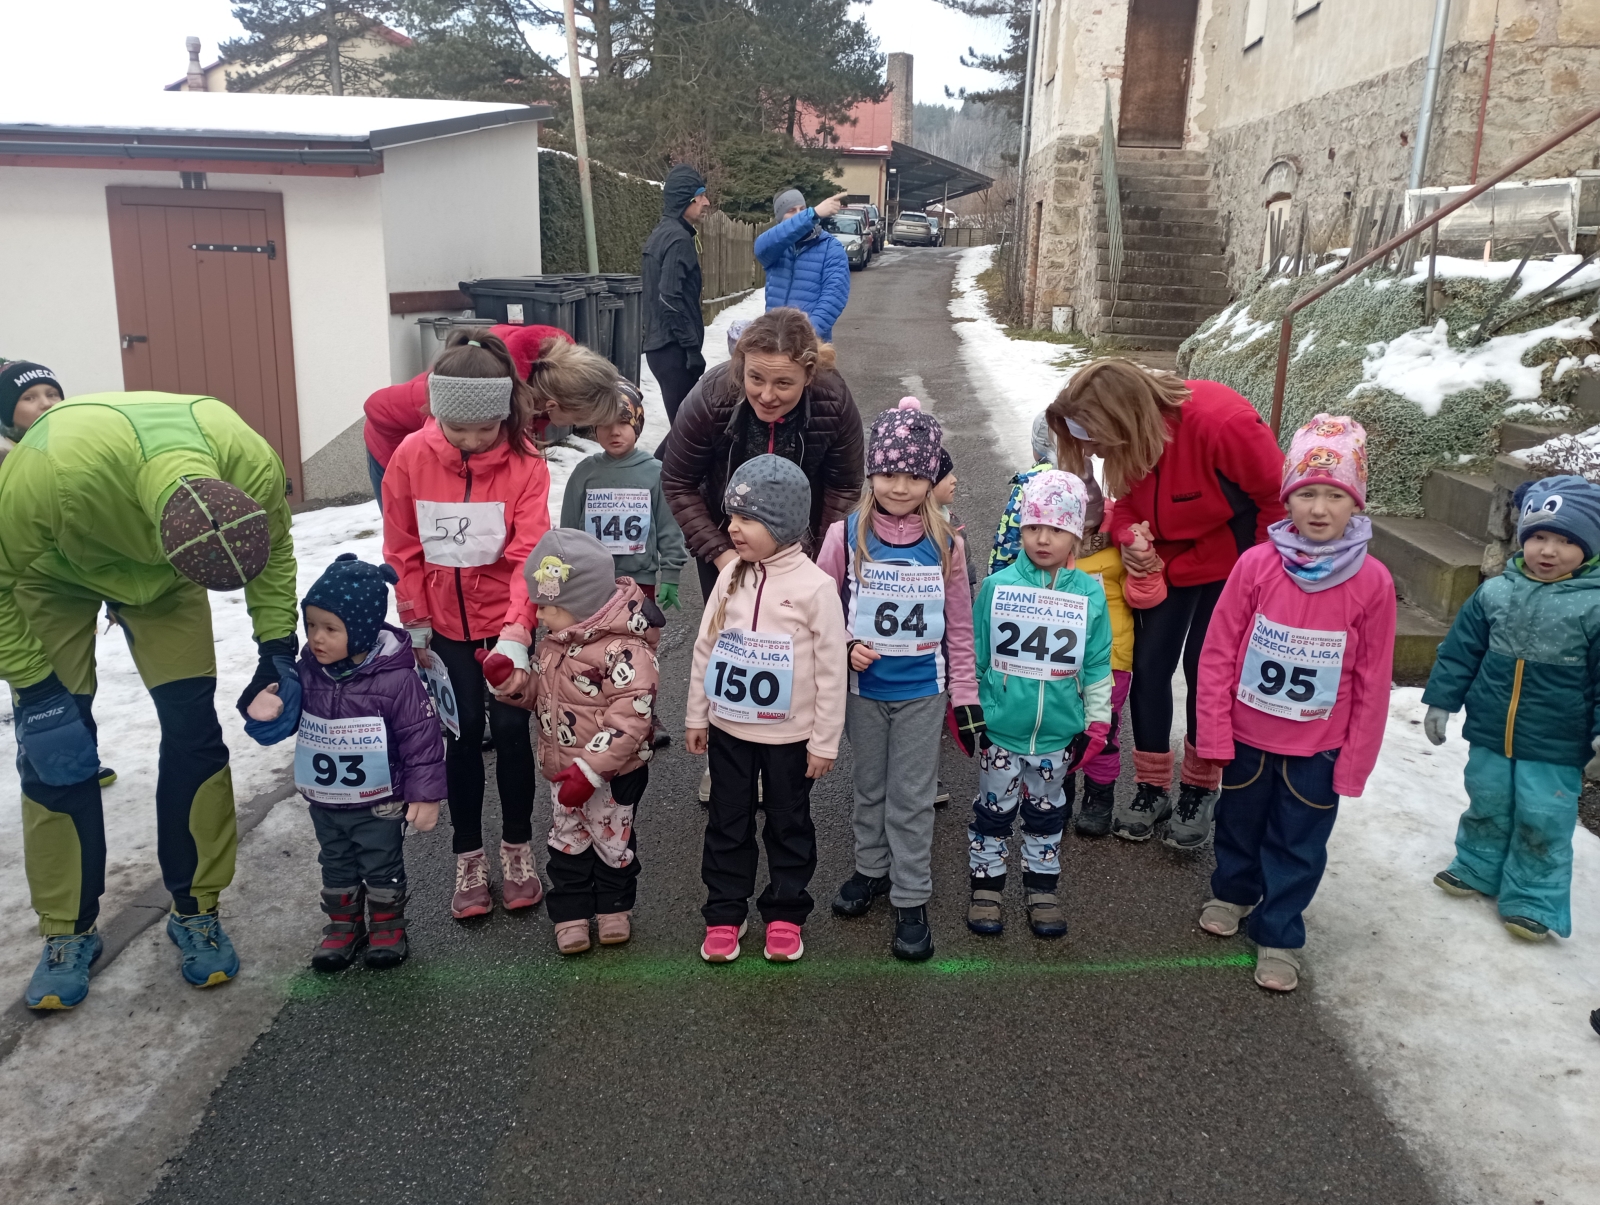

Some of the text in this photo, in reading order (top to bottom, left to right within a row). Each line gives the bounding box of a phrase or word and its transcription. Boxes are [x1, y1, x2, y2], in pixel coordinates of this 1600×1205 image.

[588, 492, 613, 500] ZIMNÍ
[430, 516, 471, 546] 58
[591, 516, 642, 541] 146
[863, 568, 899, 581] ZIMNÍ
[997, 591, 1036, 604] ZIMNÍ
[1038, 599, 1083, 610] 2024-2025
[874, 602, 927, 637] 64
[995, 602, 1083, 621] BĚŽECKÁ LIGA
[1257, 621, 1290, 642] ZIMNÍ
[718, 640, 790, 662] BĚŽECKÁ LIGA
[744, 640, 790, 650] 2024-2025
[996, 622, 1078, 664] 242
[1253, 633, 1340, 659] BĚŽECKÁ LIGA
[1291, 639, 1342, 647] 2024-2025
[714, 661, 779, 706] 150
[1258, 660, 1317, 702] 95
[757, 711, 785, 719] MARATON
[300, 717, 327, 734] ZIMNÍ
[299, 730, 382, 745] BĚŽECKÁ LIGA
[312, 753, 366, 787] 93
[359, 786, 389, 798] MARATON
